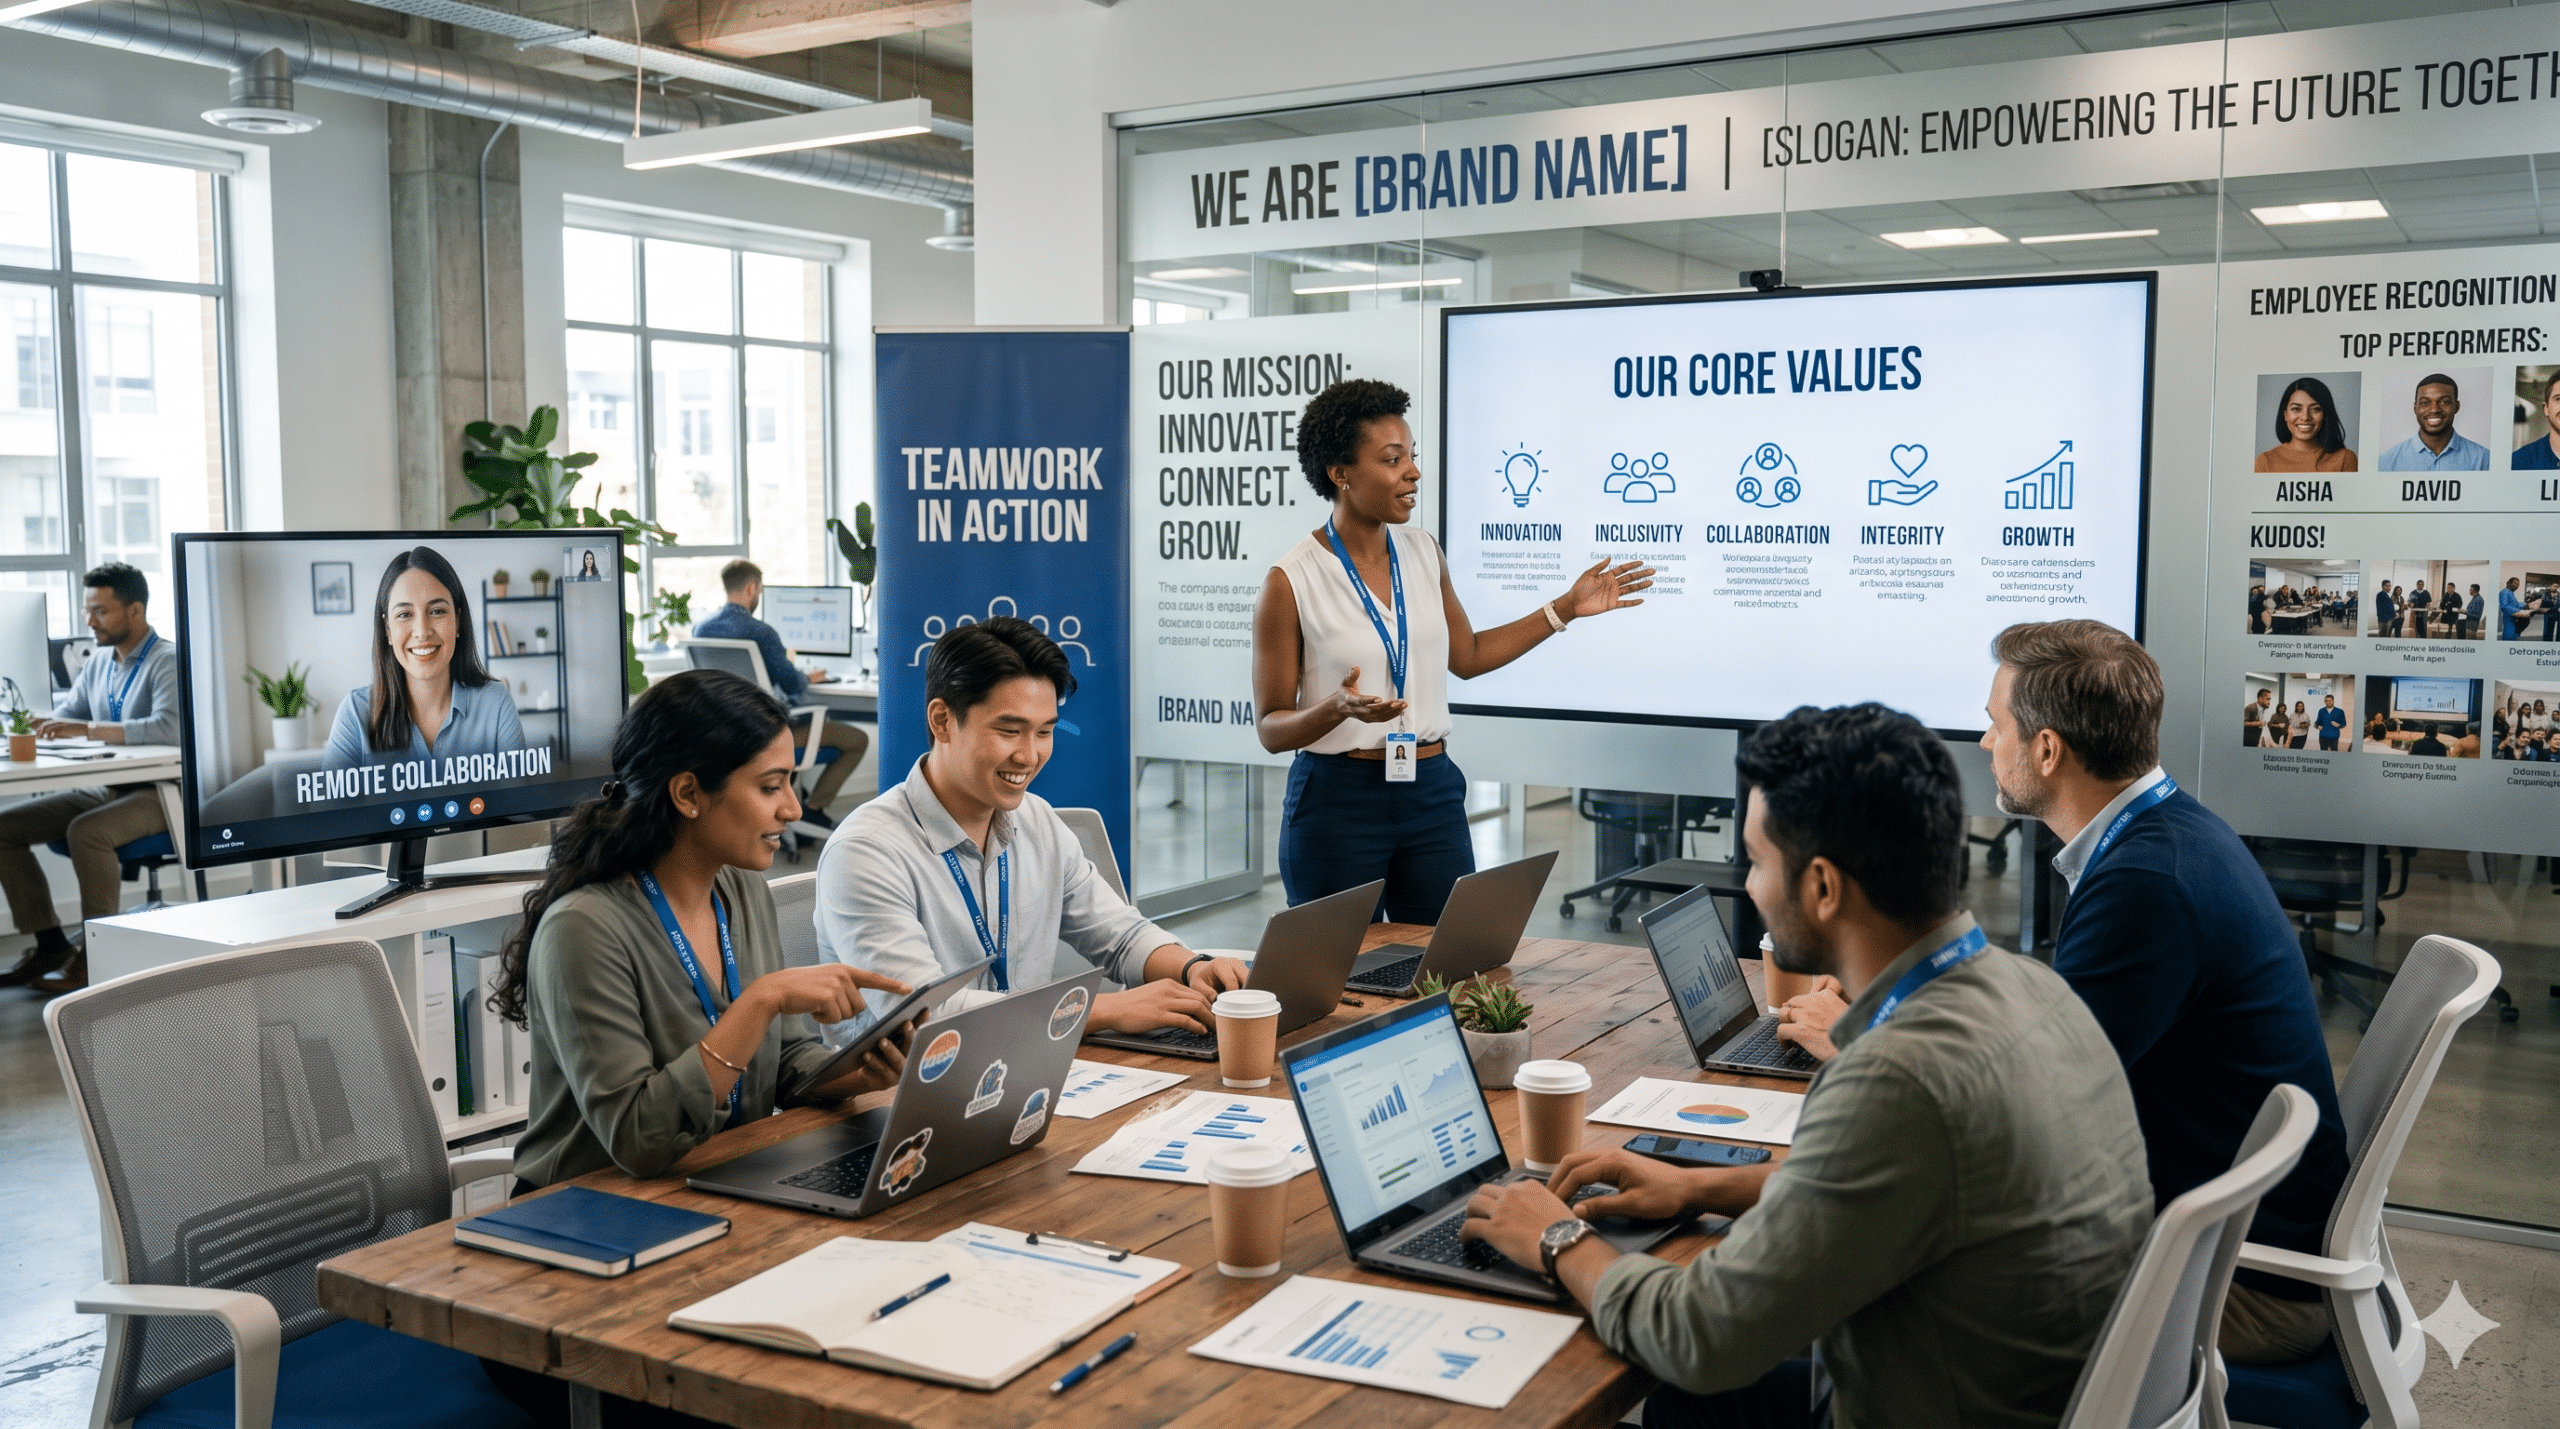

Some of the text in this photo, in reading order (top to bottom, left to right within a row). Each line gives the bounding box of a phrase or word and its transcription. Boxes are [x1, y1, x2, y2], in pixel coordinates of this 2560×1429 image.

[1763, 115, 1910, 169] [SLOGAN:
[1920, 90, 2156, 155] EMPOWERING
[2168, 82, 2238, 134] THE
[2251, 66, 2402, 126] FUTURE
[1191, 124, 1688, 229] WE ARE [BRAND NAME]
[2251, 274, 2557, 316] EMPLOYEE RECOGNITION
[2340, 326, 2548, 358] TOP PERFORMERS:
[1158, 359, 1213, 400] OUR
[1614, 345, 1922, 398] OUR CORE VALUES
[901, 447, 1103, 491] TEAMWORK
[1158, 466, 1296, 506] CONNECT.
[2276, 481, 2333, 502] AISHA
[2402, 480, 2461, 501] DAVID
[917, 498, 1088, 542] IN ACTION
[1481, 523, 1562, 541] INNOVATION
[1595, 524, 1683, 543] INCLUSIVITY
[1706, 525, 1830, 544] COLLABORATION
[1861, 526, 1944, 545] INTEGRITY
[2002, 526, 2075, 547] GROWTH
[2250, 525, 2326, 548] KUDOS!
[1158, 520, 1248, 561] GROW.
[1230, 701, 1254, 726] NA
[296, 746, 551, 804] REMOTE COLLABORATION
